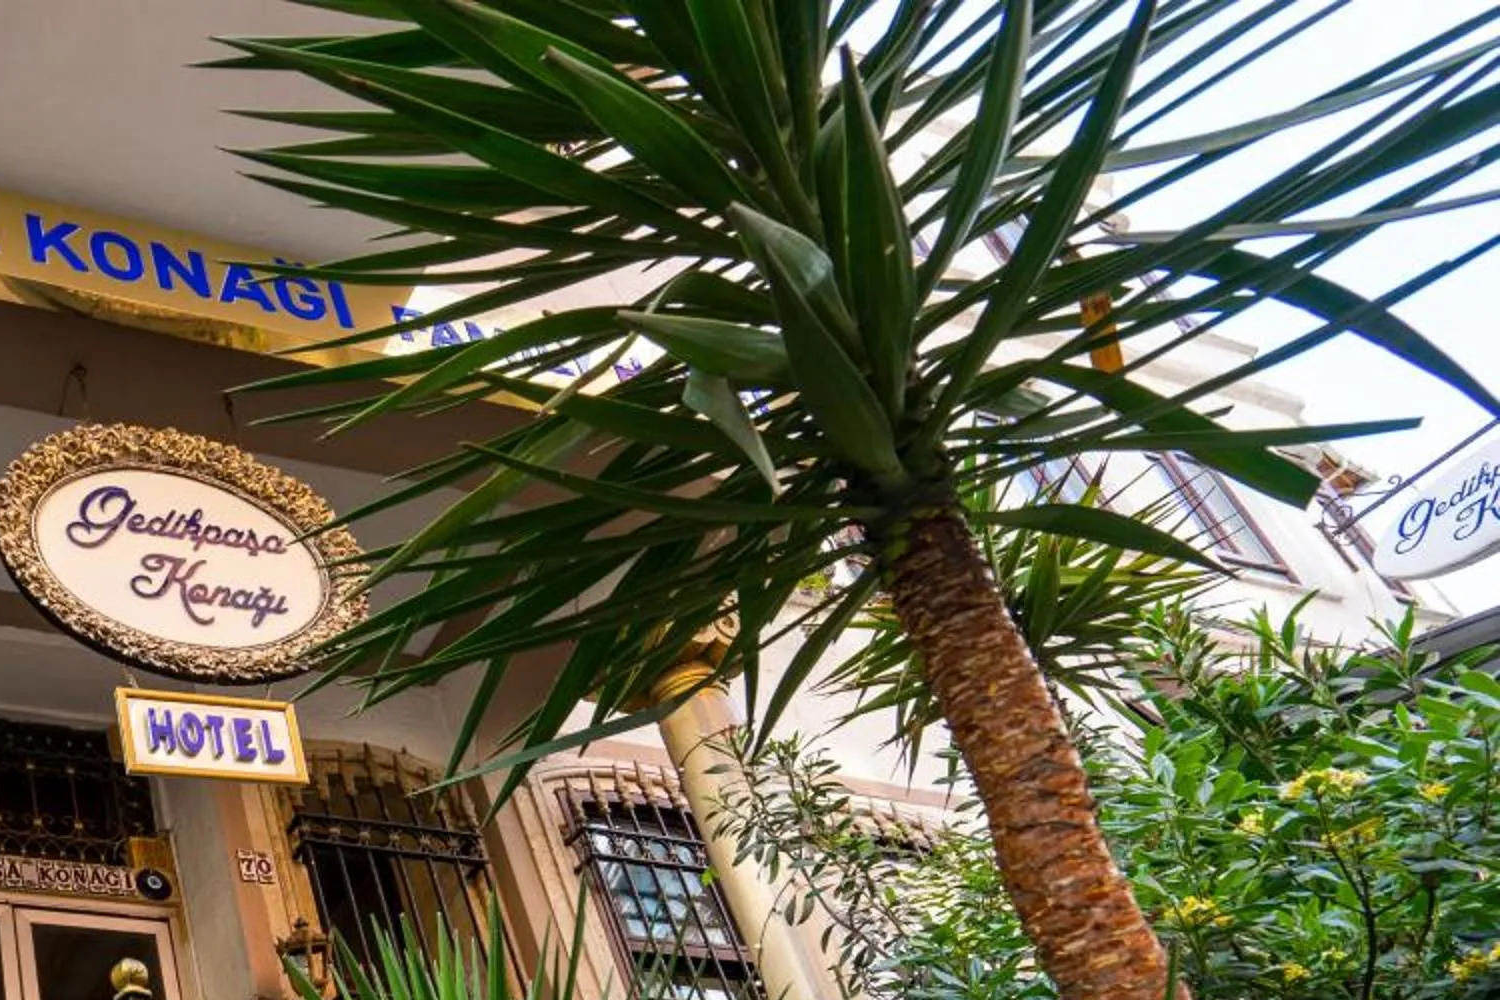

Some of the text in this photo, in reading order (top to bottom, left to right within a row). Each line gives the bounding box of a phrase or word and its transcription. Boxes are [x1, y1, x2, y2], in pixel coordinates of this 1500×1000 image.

[25, 212, 356, 329] KONAĞI
[66, 485, 288, 557] Gedikpaşa
[130, 553, 289, 629] Konağı
[146, 706, 286, 766] HOTEL
[240, 858, 272, 875] 70
